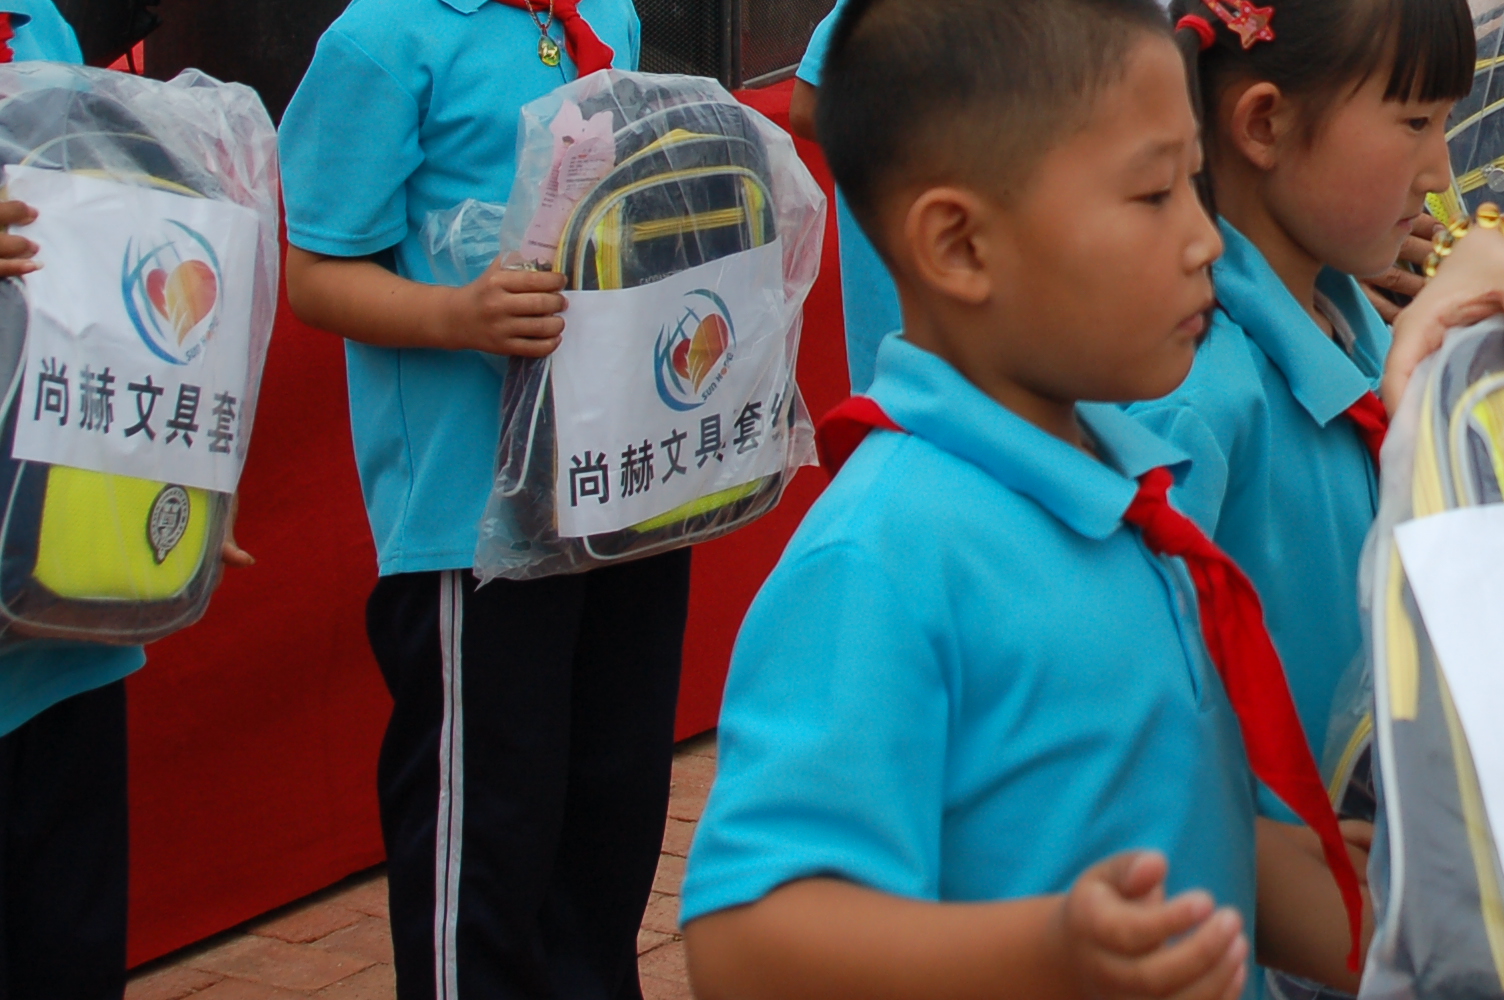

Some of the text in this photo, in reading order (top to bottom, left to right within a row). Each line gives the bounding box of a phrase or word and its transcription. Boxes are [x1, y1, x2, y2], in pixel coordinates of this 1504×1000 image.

[33, 356, 243, 456] 尚赫文具套
